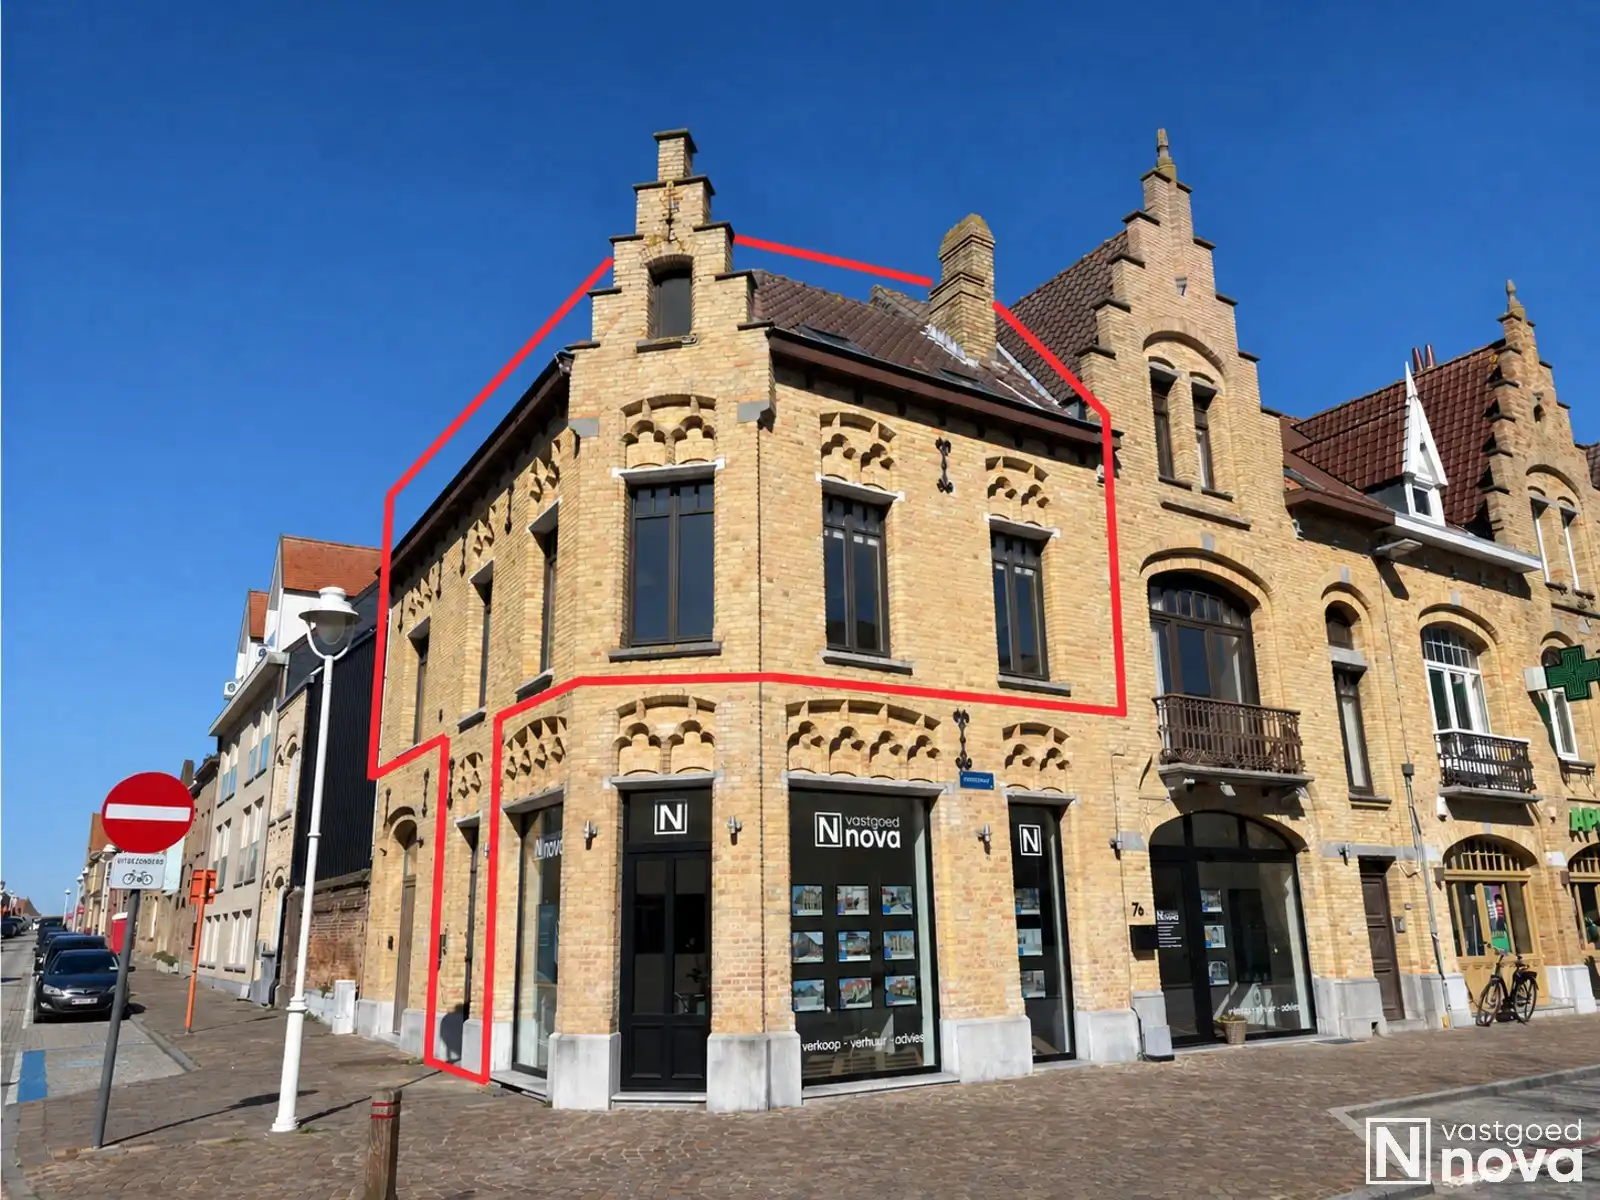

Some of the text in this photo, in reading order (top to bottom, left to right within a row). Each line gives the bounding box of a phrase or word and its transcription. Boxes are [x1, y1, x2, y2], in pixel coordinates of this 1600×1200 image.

[659, 803, 683, 831] N
[845, 816, 901, 830] vastgoed
[1569, 806, 1600, 832] AP
[818, 816, 839, 843] N
[845, 829, 901, 849] nova
[1022, 828, 1039, 852] N
[802, 1039, 841, 1052] verkoop
[851, 1036, 887, 1049] verhuur
[895, 1032, 925, 1045] advies
